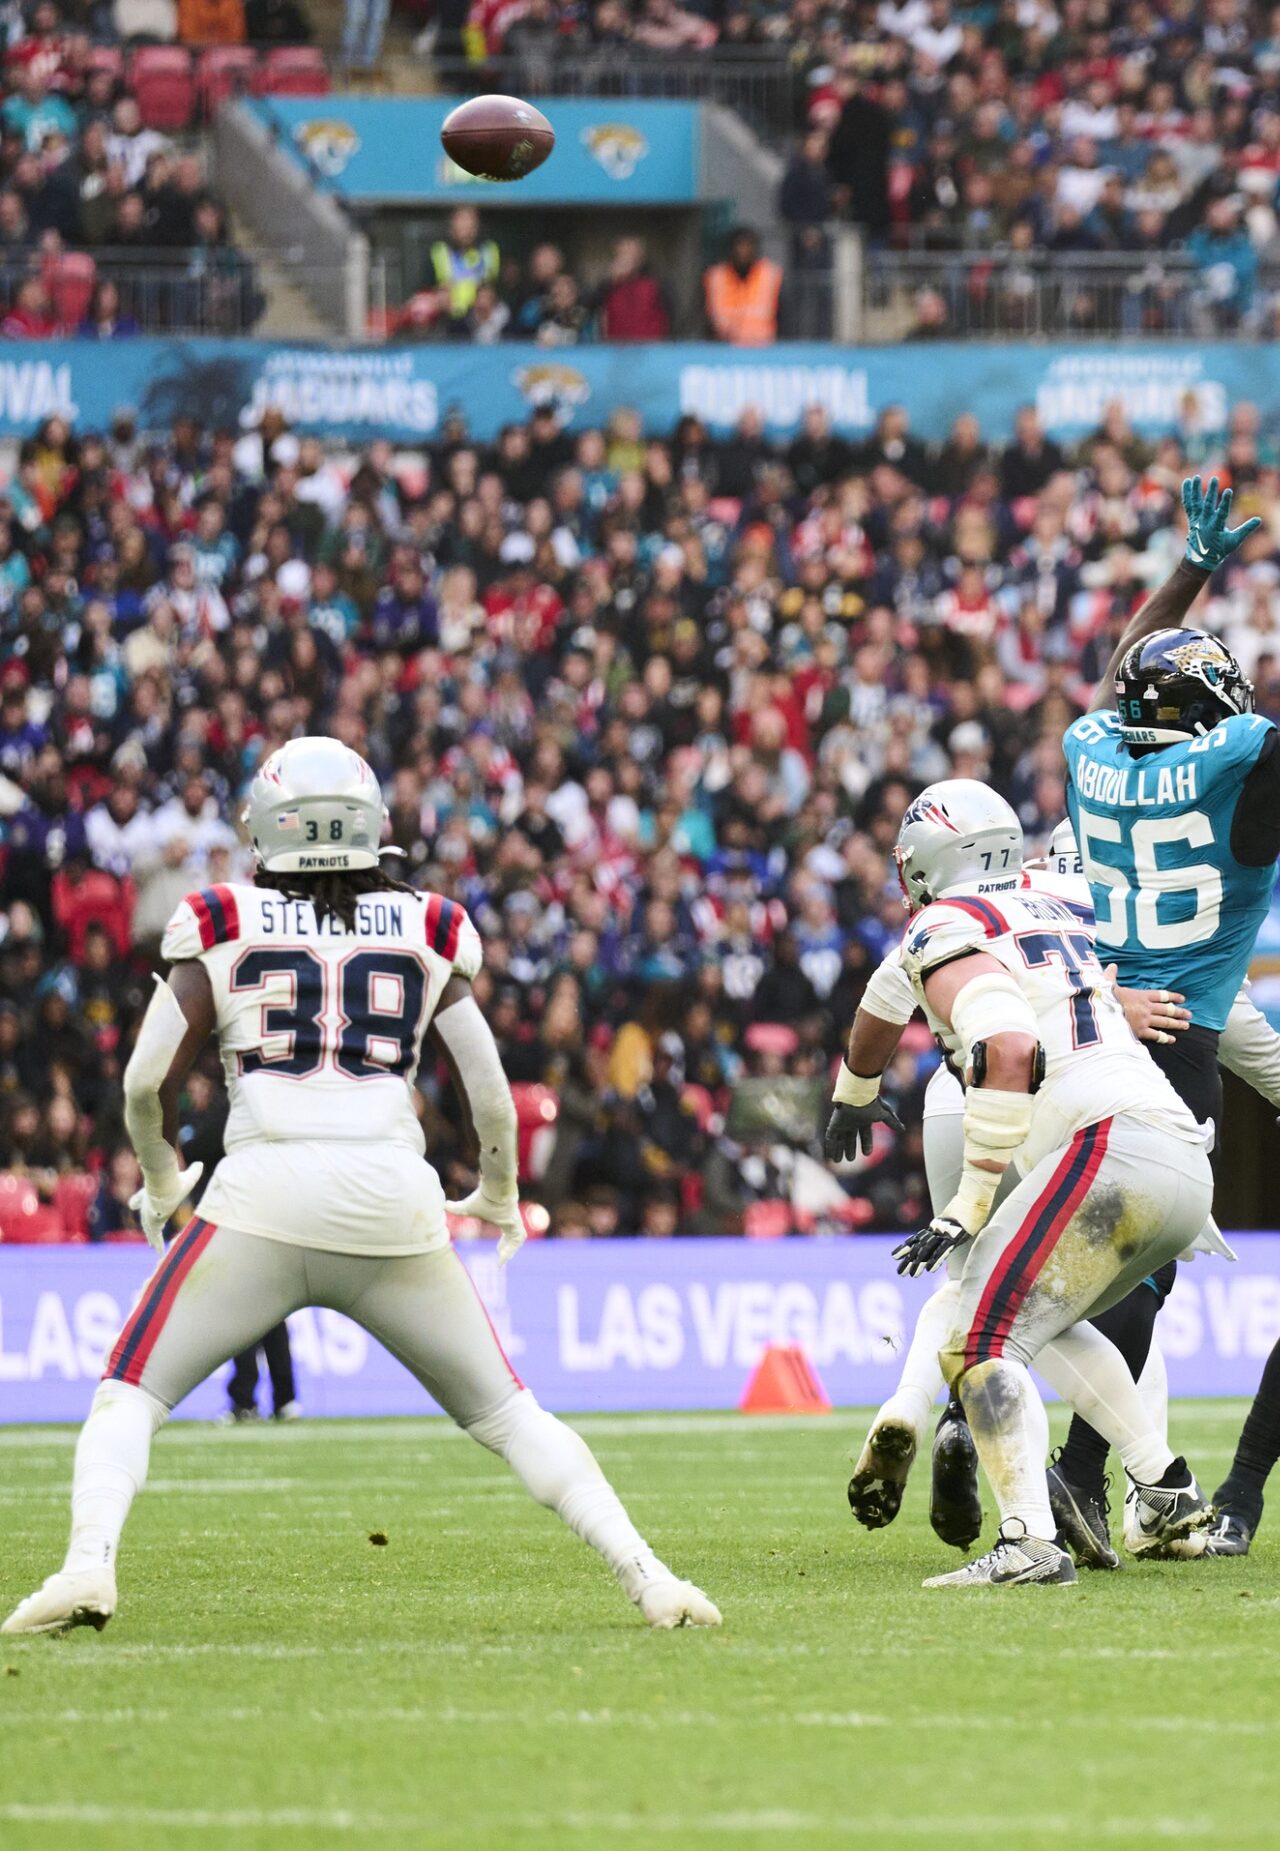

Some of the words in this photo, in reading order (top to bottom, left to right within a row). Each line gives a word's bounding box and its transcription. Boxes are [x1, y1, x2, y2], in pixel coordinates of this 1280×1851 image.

[1118, 699, 1141, 720] 56
[1076, 762, 1198, 807] ABDULLAH
[306, 820, 342, 841] 38
[299, 855, 349, 868] PATRIOTS
[980, 848, 1010, 871] 77
[1058, 856, 1083, 874] 62
[978, 879, 1017, 894] PATRIOTS
[1078, 807, 1223, 949] 56
[1013, 929, 1103, 1051] 7
[230, 945, 429, 1080] 38
[557, 1284, 684, 1371] LAS
[687, 1281, 905, 1367] VEGAS
